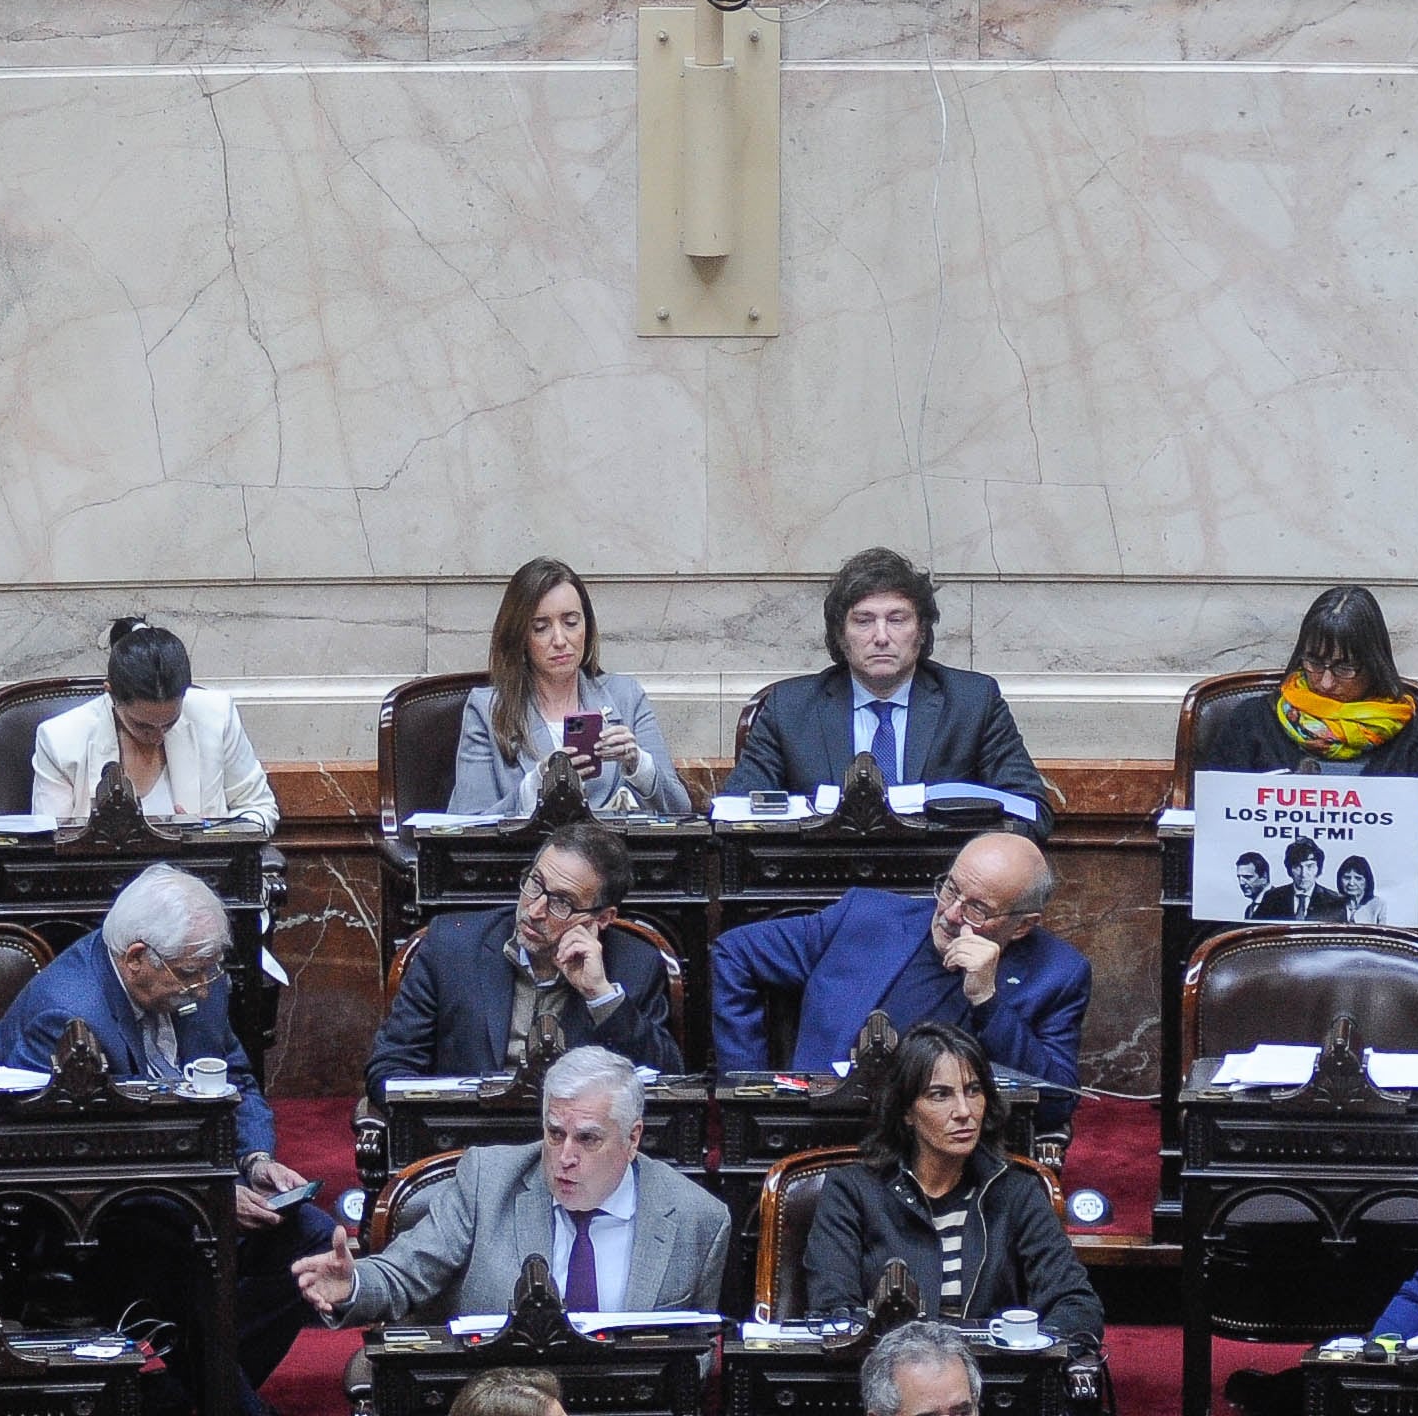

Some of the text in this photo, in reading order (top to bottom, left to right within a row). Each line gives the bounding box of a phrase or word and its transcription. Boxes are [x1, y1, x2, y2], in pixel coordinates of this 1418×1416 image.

[1257, 787, 1362, 807] FUERA
[1225, 807, 1393, 825] LOS POLÍTICOS
[1263, 826, 1354, 840] DEL FMI
